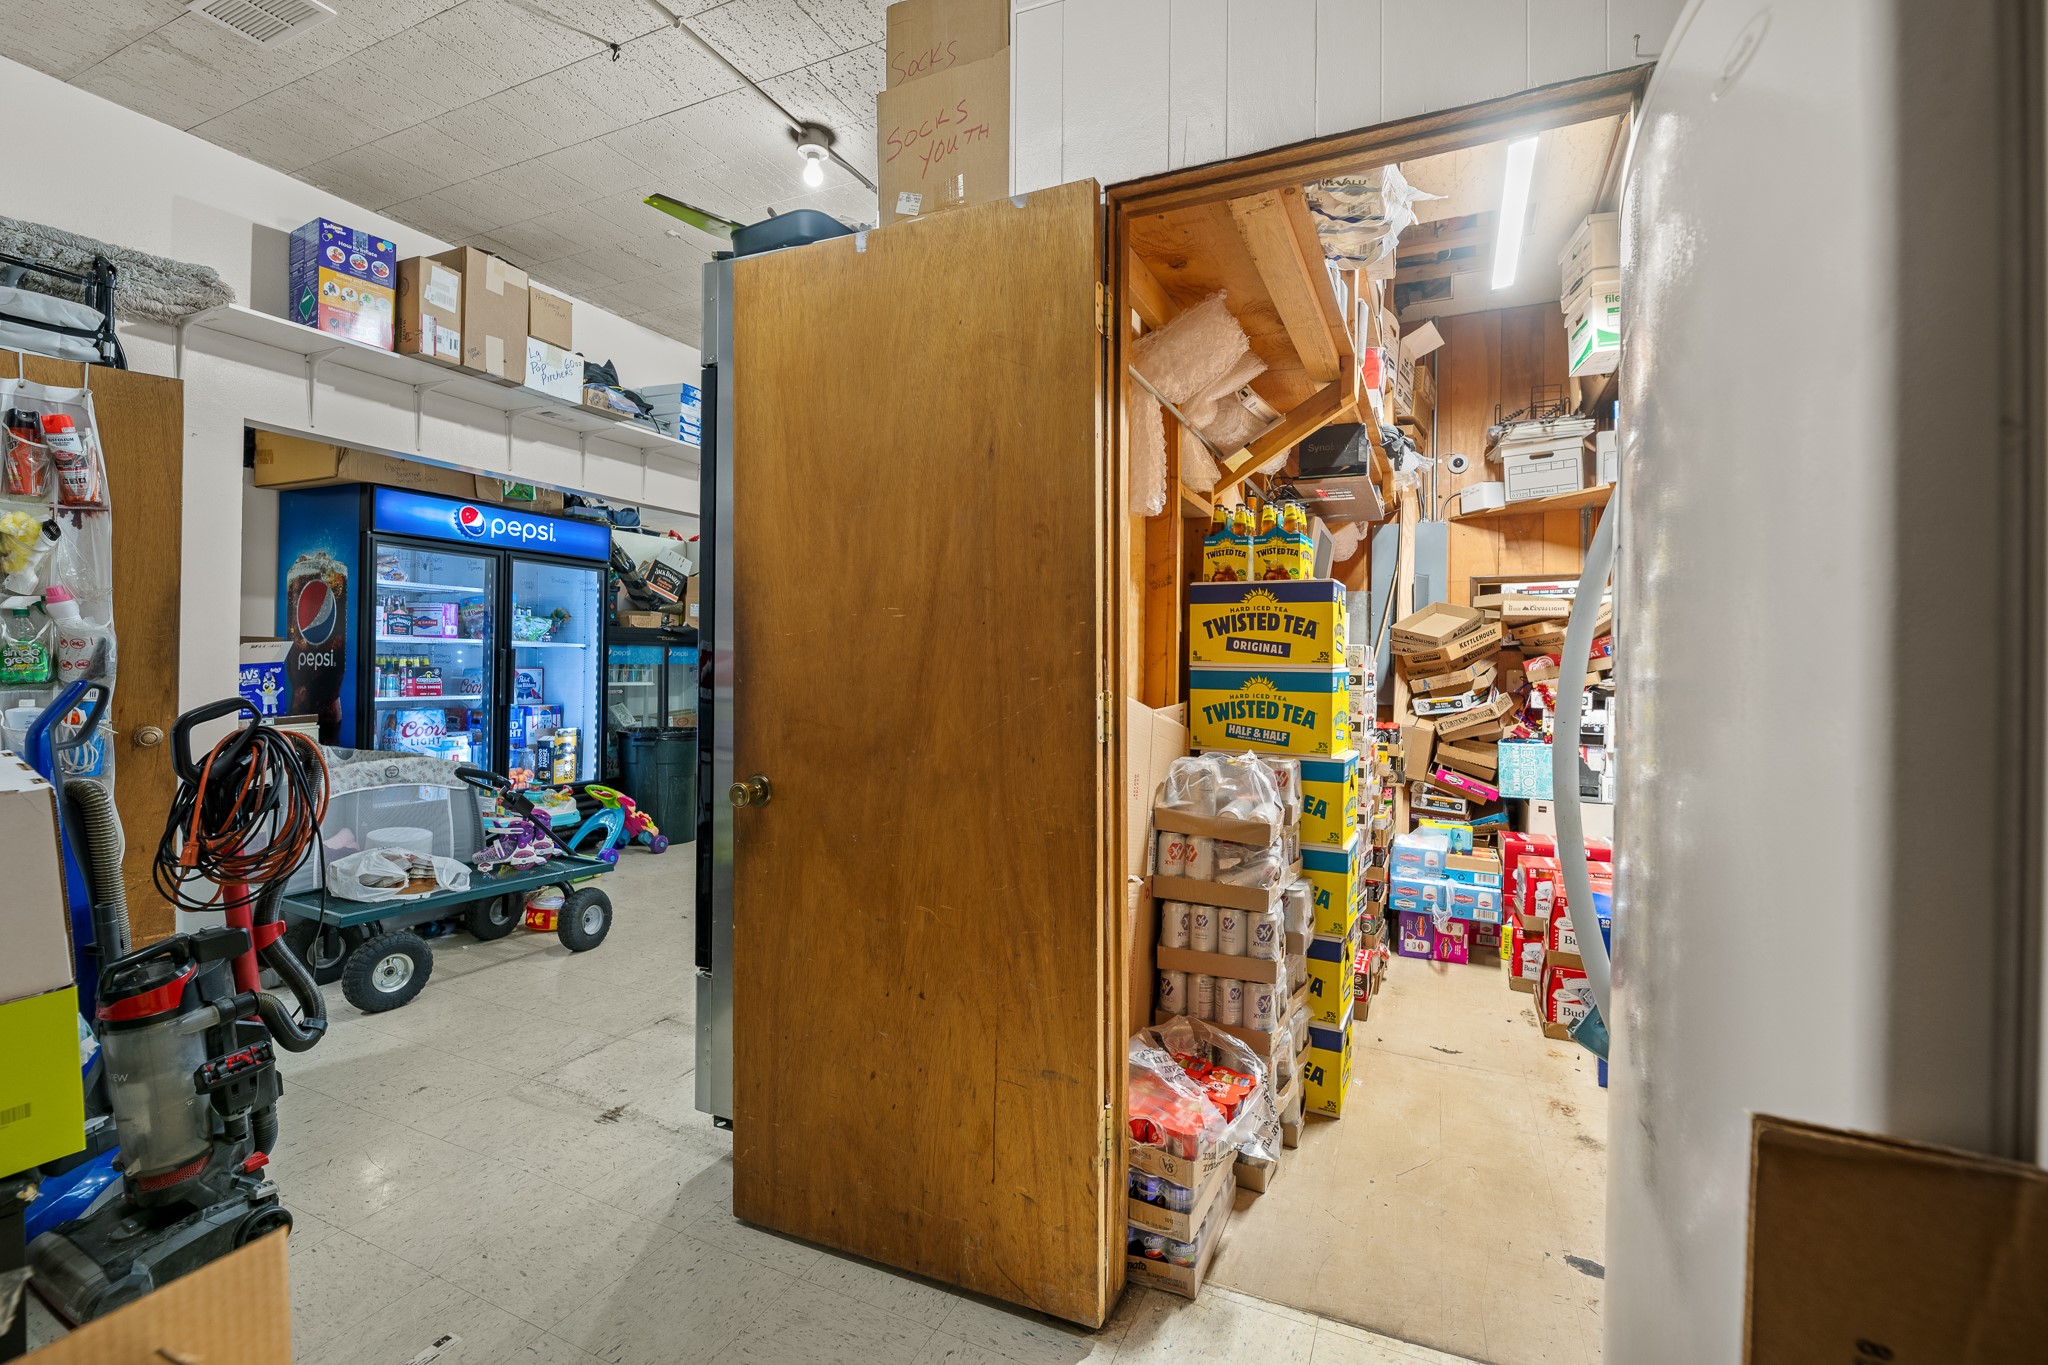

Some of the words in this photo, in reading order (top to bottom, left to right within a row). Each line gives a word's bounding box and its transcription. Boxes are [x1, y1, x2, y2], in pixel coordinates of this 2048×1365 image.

[891, 41, 957, 87] SOCKS
[887, 99, 968, 163] SOCKS
[919, 122, 990, 180] YOUTH
[531, 361, 546, 376] Pop
[491, 517, 555, 543] pepsi
[1206, 549, 1234, 559] TWISTED
[1234, 549, 1246, 559] TEA
[1256, 547, 1286, 558] TWISTED
[1286, 549, 1299, 557] TEA
[654, 568, 666, 576] JACK
[1202, 612, 1281, 639] TWISTED
[1283, 614, 1318, 640] TEA
[1458, 628, 1497, 649] KETTLEHOUSE
[3, 646, 41, 658] simple
[612, 649, 631, 657] pepsi
[672, 649, 689, 658] pepsi
[1232, 639, 1284, 654] ORIGINAL
[1482, 643, 1496, 654] LIGHT
[4, 653, 40, 667] green
[297, 649, 334, 671] pepsi
[1273, 694, 1287, 702] TEA
[1202, 700, 1280, 725] TWISTED
[1282, 703, 1316, 730] TEA
[400, 721, 447, 739] Coors
[1228, 724, 1252, 736] HALF
[1253, 728, 1261, 738] &
[1262, 729, 1287, 742] HALF
[410, 737, 441, 746] LIGHT
[1303, 794, 1328, 820] EA
[1329, 832, 1340, 840] 5%
[1313, 885, 1331, 910] EA
[1333, 922, 1343, 931] 5%
[1325, 1011, 1336, 1020] 5%
[1304, 1062, 1325, 1087] EA
[1326, 1100, 1337, 1109] 5%
[1162, 1157, 1174, 1174] V8
[1169, 1242, 1196, 1254] Clamato
